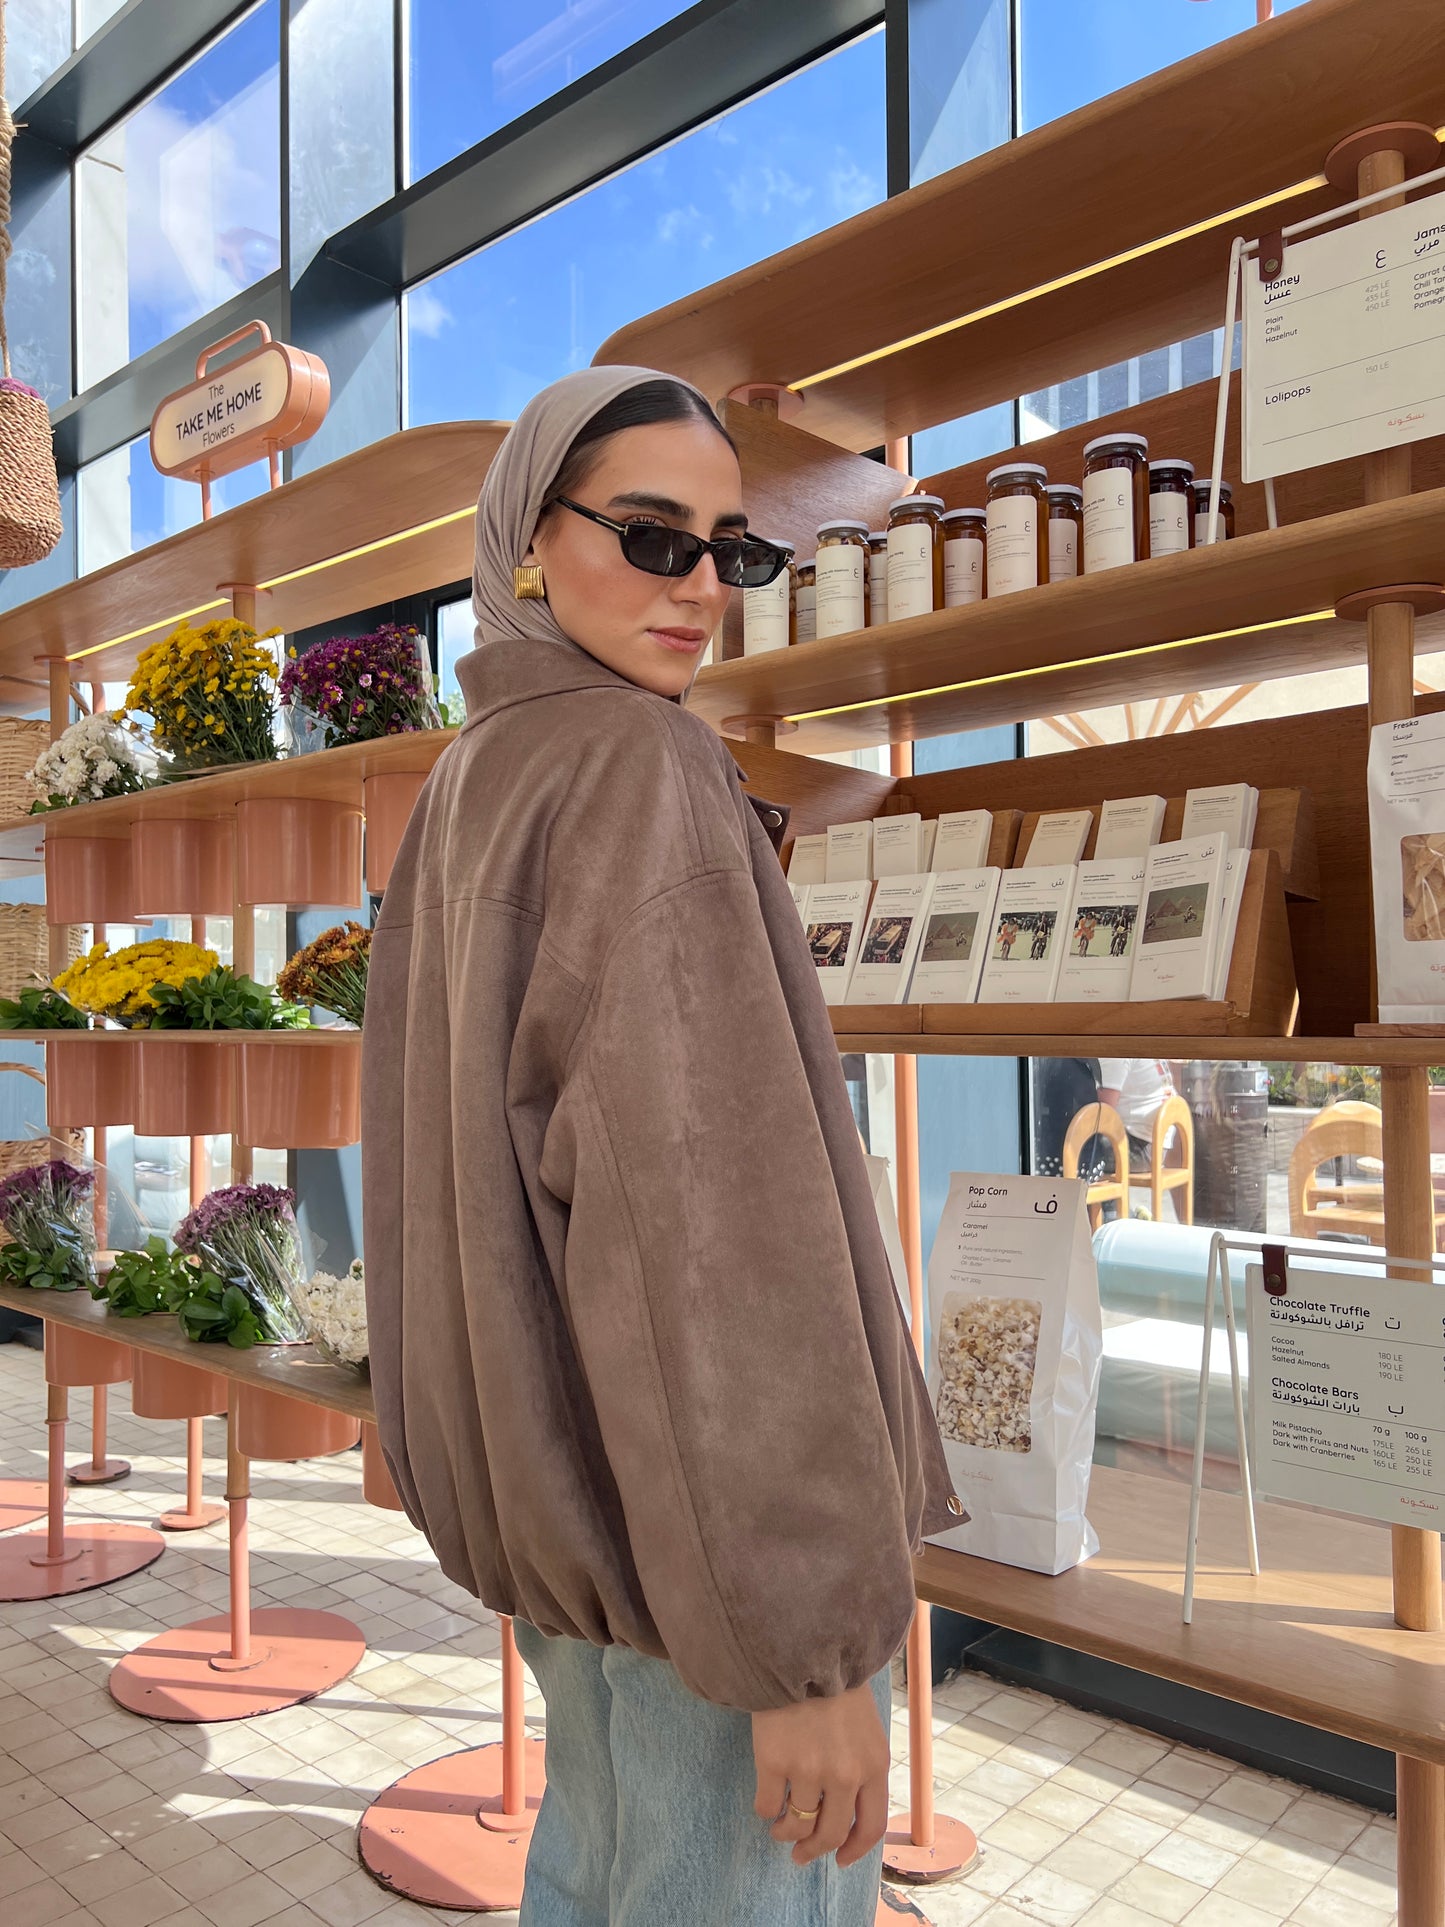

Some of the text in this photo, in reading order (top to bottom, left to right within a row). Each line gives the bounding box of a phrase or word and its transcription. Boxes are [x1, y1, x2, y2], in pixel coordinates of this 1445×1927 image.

[1413, 268, 1440, 281] Carrot
[1265, 274, 1300, 292] Honey
[1264, 289, 1291, 305] عسل
[1413, 286, 1445, 300] Orange
[1265, 315, 1284, 326] Plain
[1265, 324, 1281, 335] Chili
[1265, 329, 1298, 344] Hazelnut
[1380, 361, 1390, 370] LE
[208, 384, 225, 401] The
[1265, 385, 1311, 405] Lolipops
[176, 382, 262, 441] TAKE ME HOME
[202, 423, 235, 448] Flowers
[1393, 720, 1419, 730] Freska
[968, 1186, 1008, 1196] Pop Corn
[1034, 1194, 1058, 1214] ف
[962, 1222, 988, 1230] Caramel
[1269, 1296, 1371, 1318] Chocolate Truffle
[1384, 1317, 1401, 1330] ت
[1271, 1335, 1295, 1346] Cocoa
[1271, 1345, 1305, 1356] Hazelnut
[1378, 1351, 1403, 1362] 180 LE
[1272, 1354, 1331, 1370] Salted Almonds
[1378, 1361, 1392, 1370] 190
[1379, 1371, 1404, 1382] 190 LE
[1271, 1377, 1360, 1400] Chocolate Bars
[1332, 1401, 1361, 1416] بارات
[1388, 1405, 1404, 1418] ب
[1272, 1420, 1323, 1436] Milk Pistachio
[1373, 1425, 1391, 1437] 70 g
[1272, 1429, 1369, 1454] Dark with Fruits and Nuts
[1405, 1431, 1428, 1444] 100 g
[1273, 1438, 1356, 1461] Dark with Cranberries
[1405, 1445, 1432, 1457] 265 LE
[1373, 1459, 1398, 1470] 165 LE
[1405, 1455, 1433, 1467] 250 LE
[1406, 1465, 1433, 1477] 255 LE
